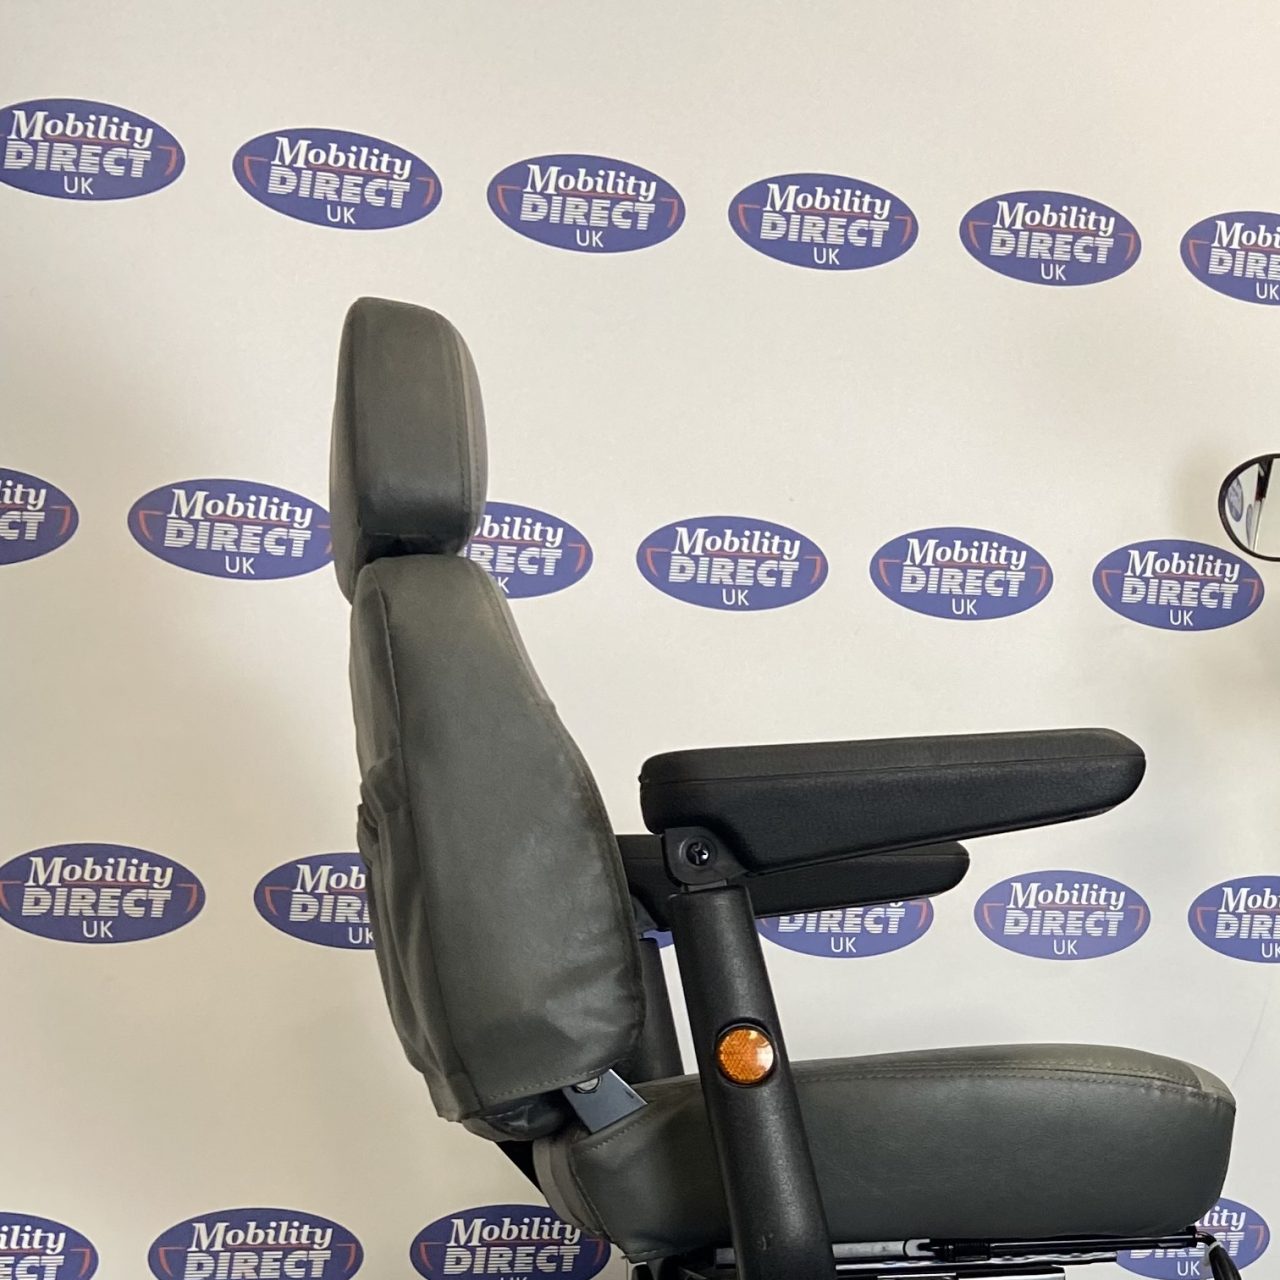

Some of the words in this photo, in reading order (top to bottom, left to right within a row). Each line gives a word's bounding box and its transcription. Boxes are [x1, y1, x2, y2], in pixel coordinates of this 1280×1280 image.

[6, 109, 153, 148] Mobility
[2, 140, 151, 177] DIRECT
[270, 136, 412, 180] Mobility
[63, 176, 94, 196] UK
[267, 166, 411, 209] DIRECT
[522, 164, 656, 201] Mobility
[326, 204, 356, 224] UK
[519, 194, 655, 230] DIRECT
[762, 183, 891, 219] Mobility
[759, 212, 890, 247] DIRECT
[992, 201, 1115, 236] Mobility
[575, 228, 603, 247] UK
[989, 229, 1114, 264] DIRECT
[813, 246, 840, 265] UK
[1040, 262, 1066, 281] UK
[1255, 282, 1280, 300] UK
[167, 489, 313, 528] Mobility
[163, 519, 312, 557] DIRECT
[474, 515, 564, 548] bility
[671, 527, 800, 560] Mobility
[224, 555, 255, 575] UK
[463, 543, 562, 576] RECT
[902, 538, 1027, 570] Mobility
[1124, 550, 1240, 583] Mobility
[668, 556, 799, 587] DIRECT
[900, 566, 1026, 597] DIRECT
[722, 588, 749, 606] UK
[951, 598, 977, 615] UK
[1121, 577, 1239, 609] DIRECT
[1169, 609, 1193, 626] UK
[23, 857, 173, 888] Mobility
[20, 887, 171, 917] DIRECT
[289, 893, 371, 924] DIR
[1006, 882, 1125, 910] Mobility
[82, 920, 113, 938] UK
[778, 908, 906, 934] DIRECT
[1003, 909, 1124, 936] DIRECT
[830, 937, 857, 953] UK
[1053, 939, 1078, 955] UK
[446, 1217, 582, 1247] Mobility
[1195, 1205, 1246, 1231] lity
[0, 1225, 66, 1254] ility
[187, 1222, 333, 1252] Mobility
[183, 1250, 331, 1280] DIRECT
[443, 1245, 581, 1275] DIRECT
[1177, 1260, 1200, 1276] UK
